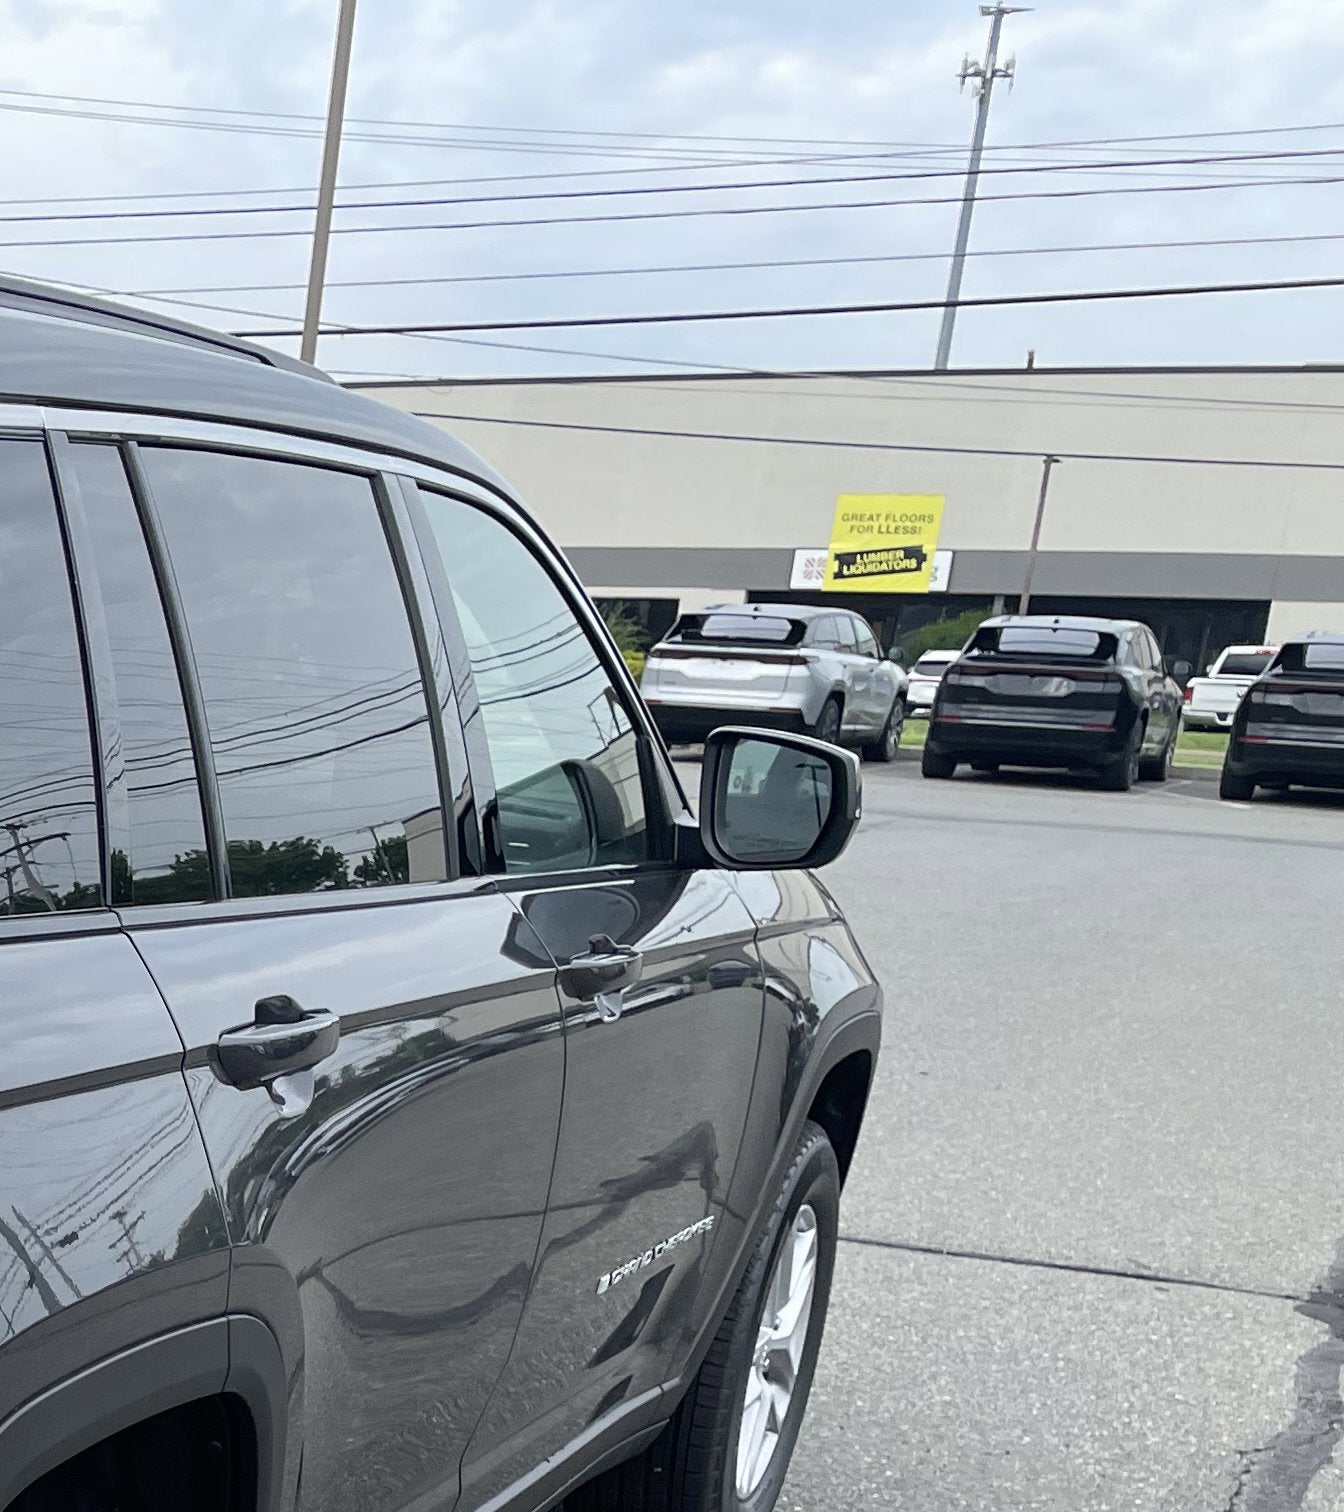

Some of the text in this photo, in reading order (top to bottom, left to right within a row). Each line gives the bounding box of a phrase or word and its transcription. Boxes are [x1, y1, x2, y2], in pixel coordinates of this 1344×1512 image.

[841, 512, 935, 524] GREAT FLOORS
[849, 525, 922, 535] FOR LLESS!
[856, 549, 905, 563] LUMBER
[842, 558, 918, 576] LIQUIDATORS
